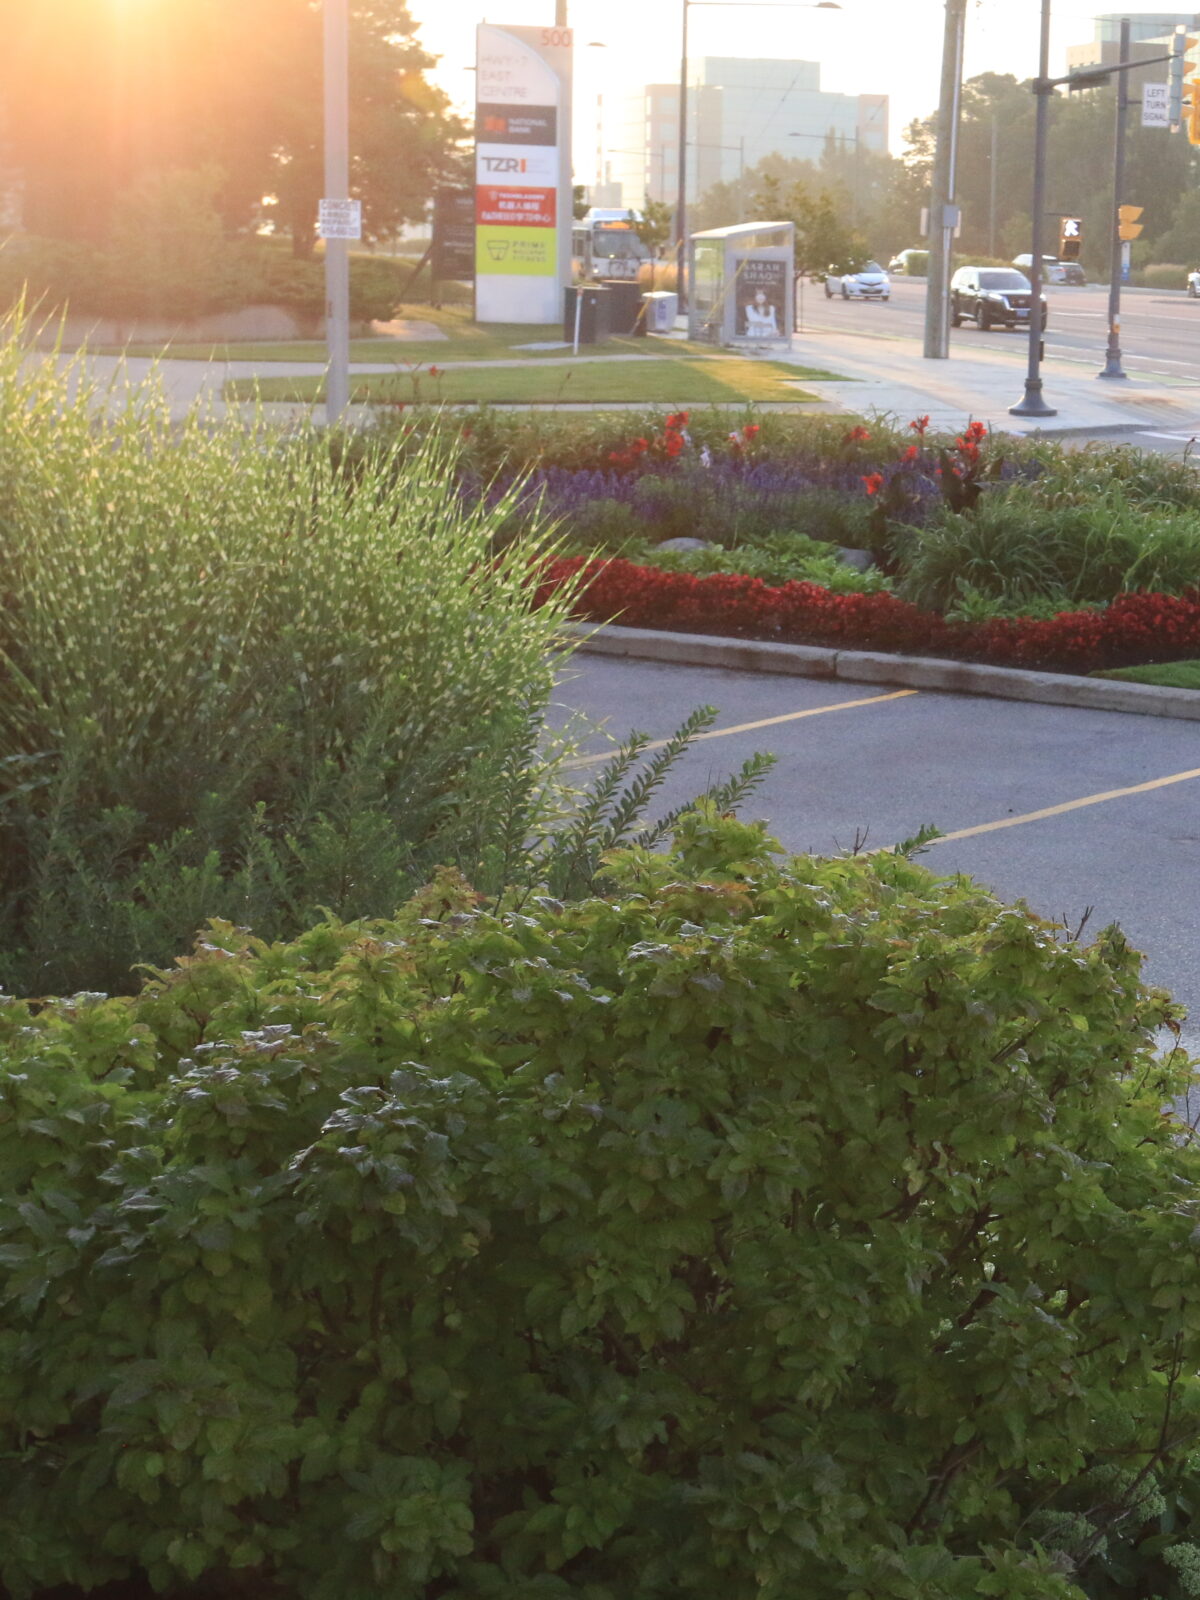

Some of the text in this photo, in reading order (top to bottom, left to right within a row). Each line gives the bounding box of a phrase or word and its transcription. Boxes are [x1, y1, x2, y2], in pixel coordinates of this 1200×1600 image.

[541, 29, 572, 48] 500
[481, 70, 512, 82] EAST
[481, 85, 529, 98] CENTRE
[1147, 89, 1165, 98] LEFT
[1146, 101, 1166, 110] TURN
[1143, 112, 1167, 121] SIGNAL
